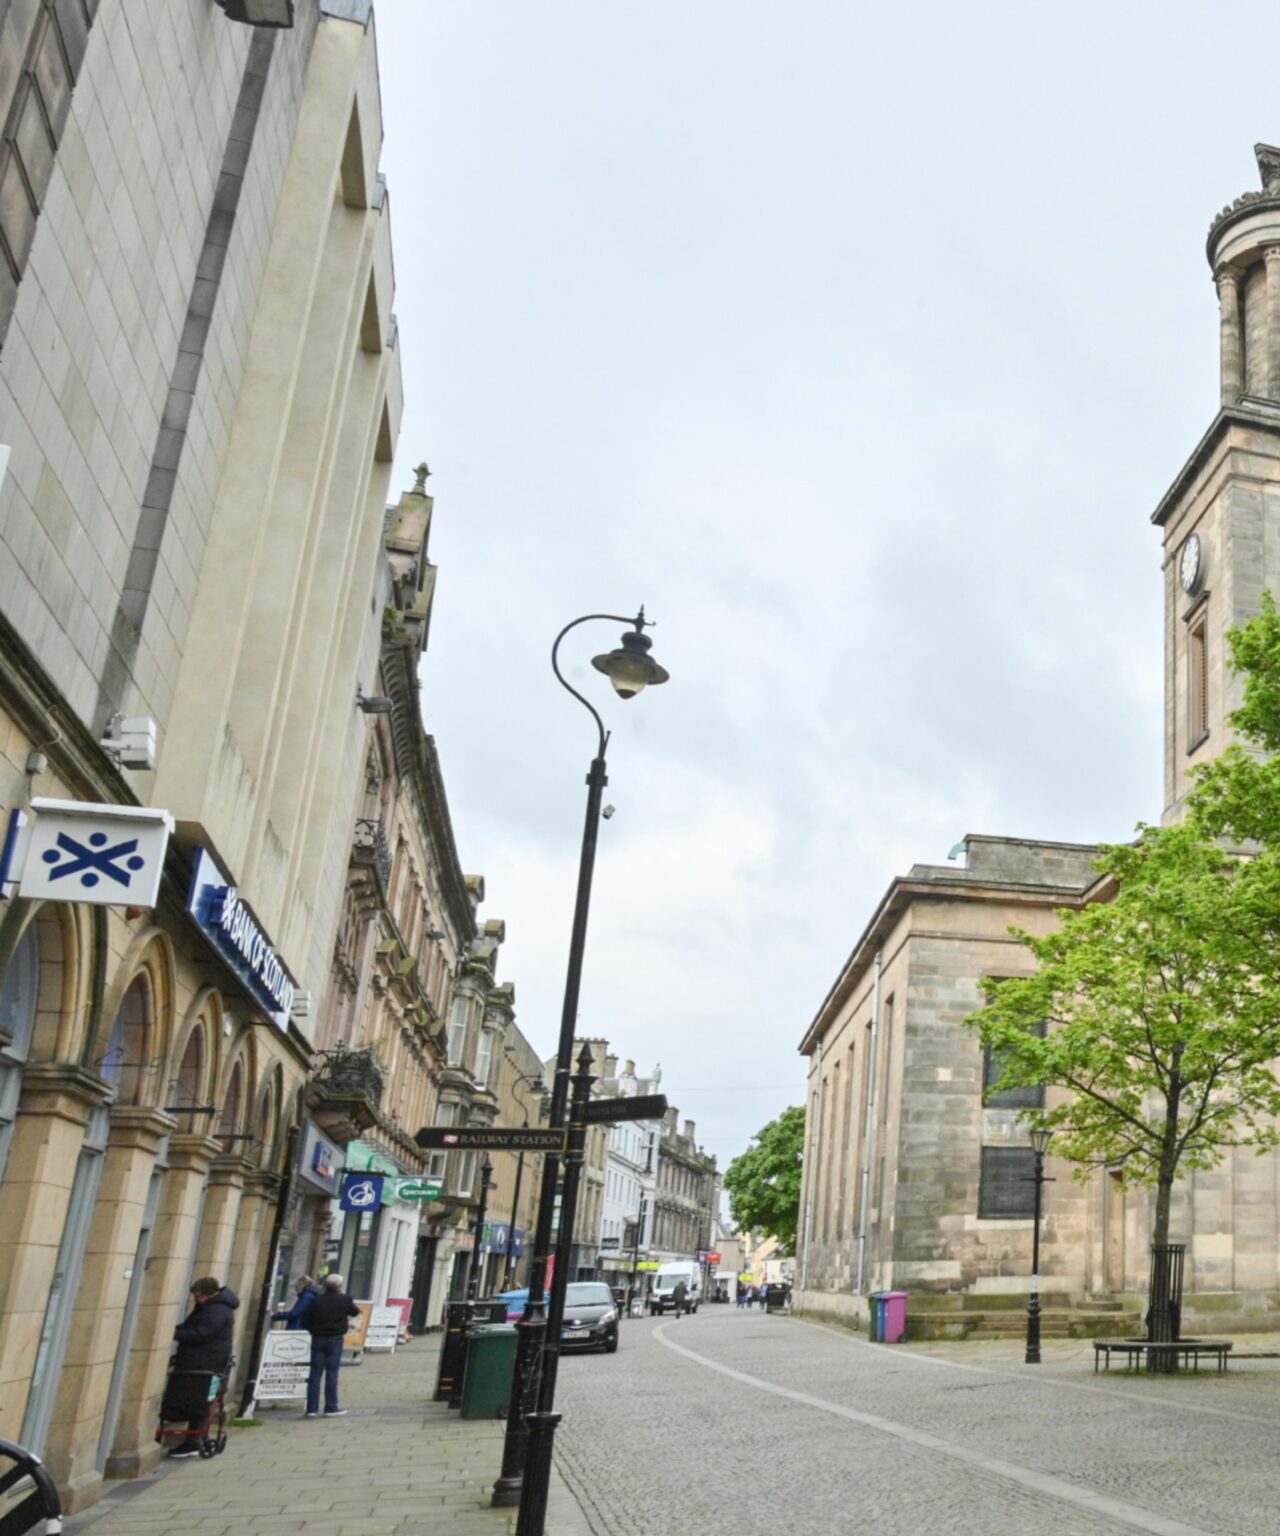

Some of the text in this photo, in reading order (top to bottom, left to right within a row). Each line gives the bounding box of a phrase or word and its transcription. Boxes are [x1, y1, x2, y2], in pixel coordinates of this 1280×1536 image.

[230, 901, 258, 963] BANK
[261, 945, 294, 1014] SCOTLAND
[460, 1134, 562, 1145] RAILWAY STATION
[402, 1188, 438, 1197] Specsavers
